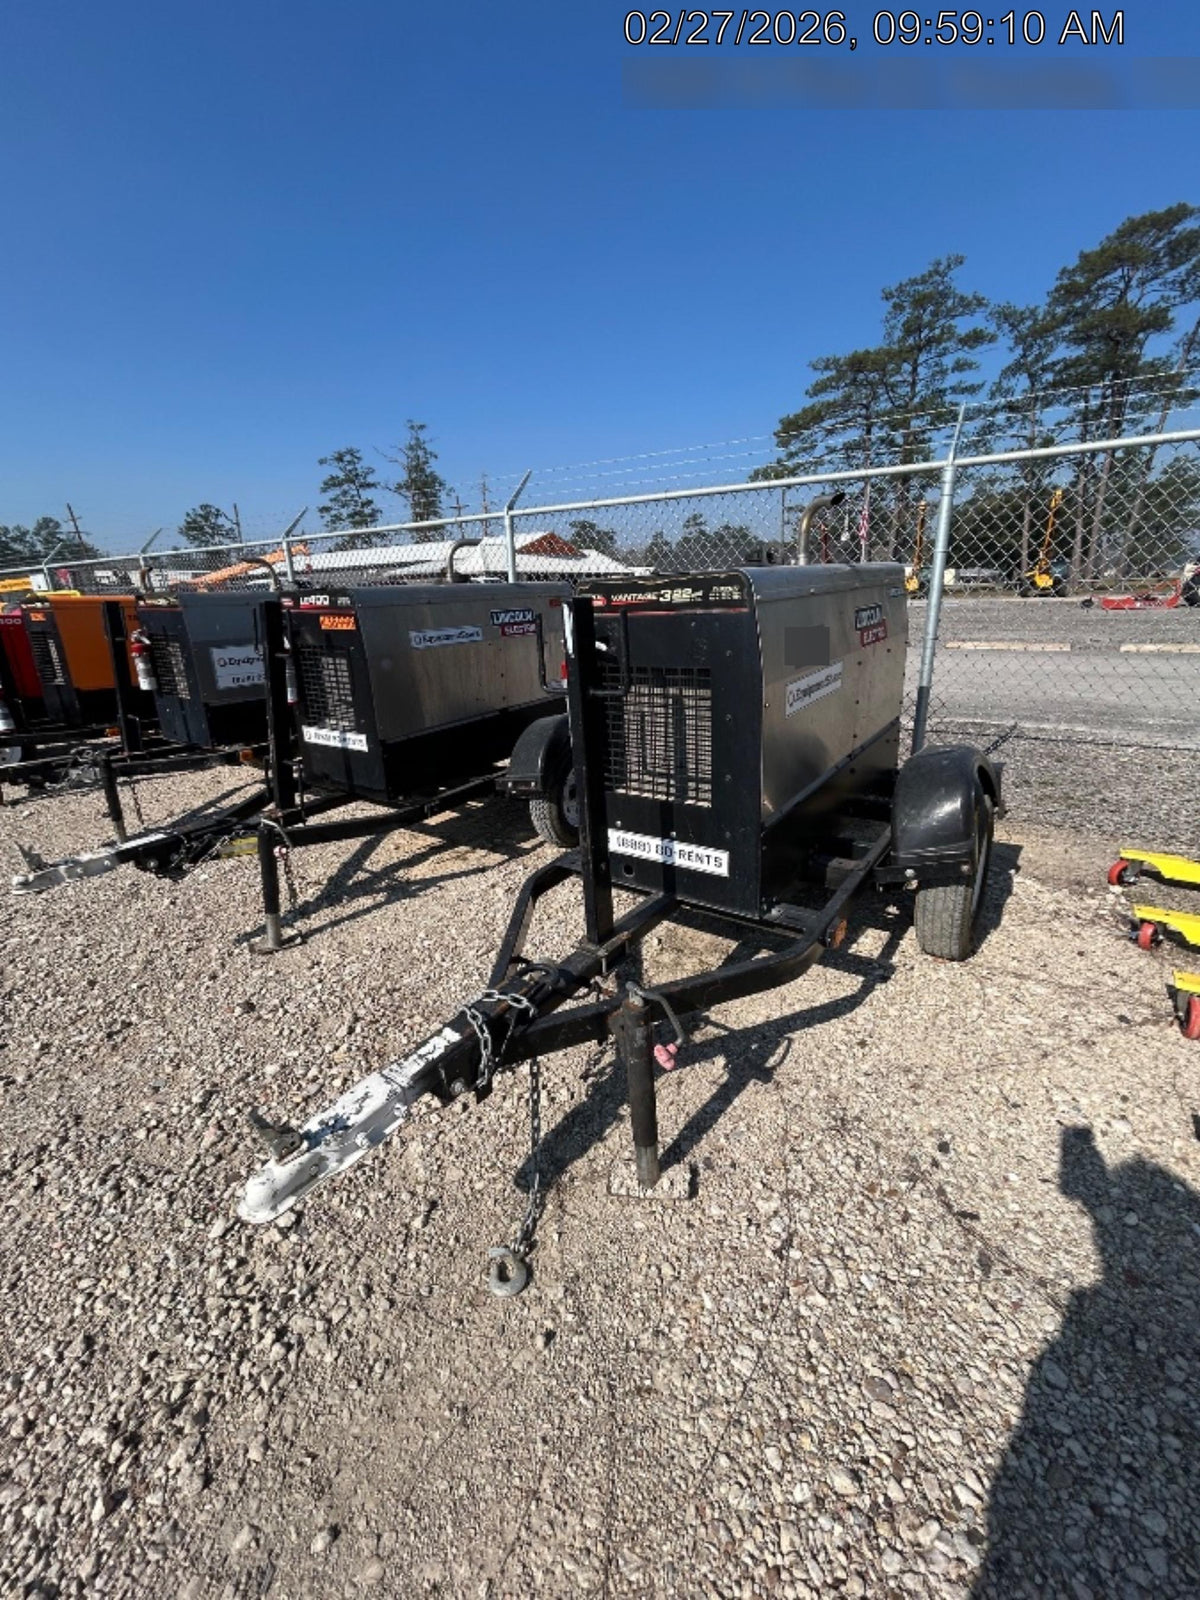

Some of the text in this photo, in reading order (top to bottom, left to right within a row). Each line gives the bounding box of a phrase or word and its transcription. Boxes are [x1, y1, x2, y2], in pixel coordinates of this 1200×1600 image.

[611, 591, 658, 602] VANTAGE
[492, 610, 534, 624] LINCOLN
[857, 606, 881, 628] LINCOLN
[616, 834, 652, 854] (888)
